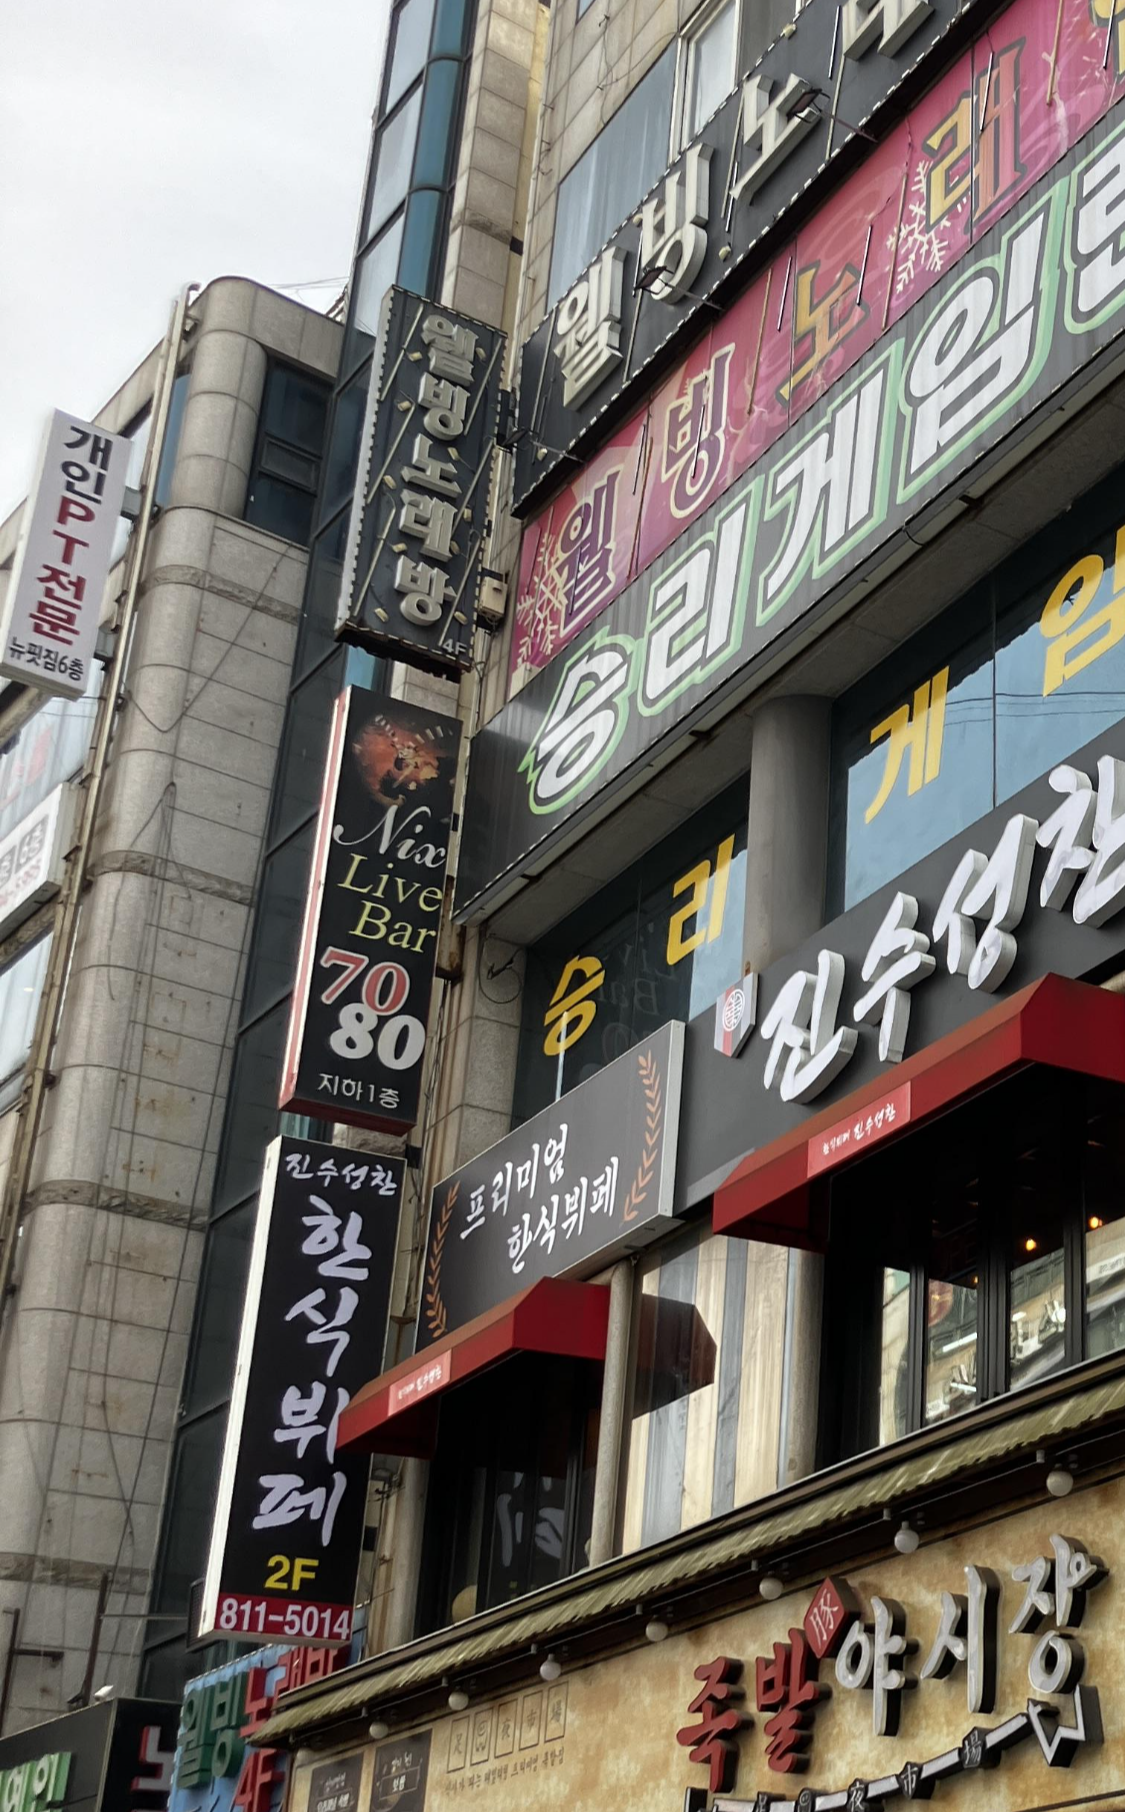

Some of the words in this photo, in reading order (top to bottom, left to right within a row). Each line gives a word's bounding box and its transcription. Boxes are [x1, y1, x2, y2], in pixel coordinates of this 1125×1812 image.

[441, 639, 467, 656] 4F
[333, 804, 446, 869] Nix
[337, 853, 443, 913] Live
[349, 901, 438, 954] Bar
[319, 945, 411, 1016] 70
[329, 1003, 426, 1071] 80
[285, 1153, 398, 1196] 진수성찬
[459, 1123, 569, 1240] 프리미엄
[507, 1156, 620, 1274] 한식뷔페
[252, 1194, 372, 1547] 한식뷔페
[264, 1555, 319, 1591] 2F
[219, 1597, 351, 1641] 811-5014
[676, 1628, 826, 1794] 족발
[835, 1533, 1106, 1737] 야시장
